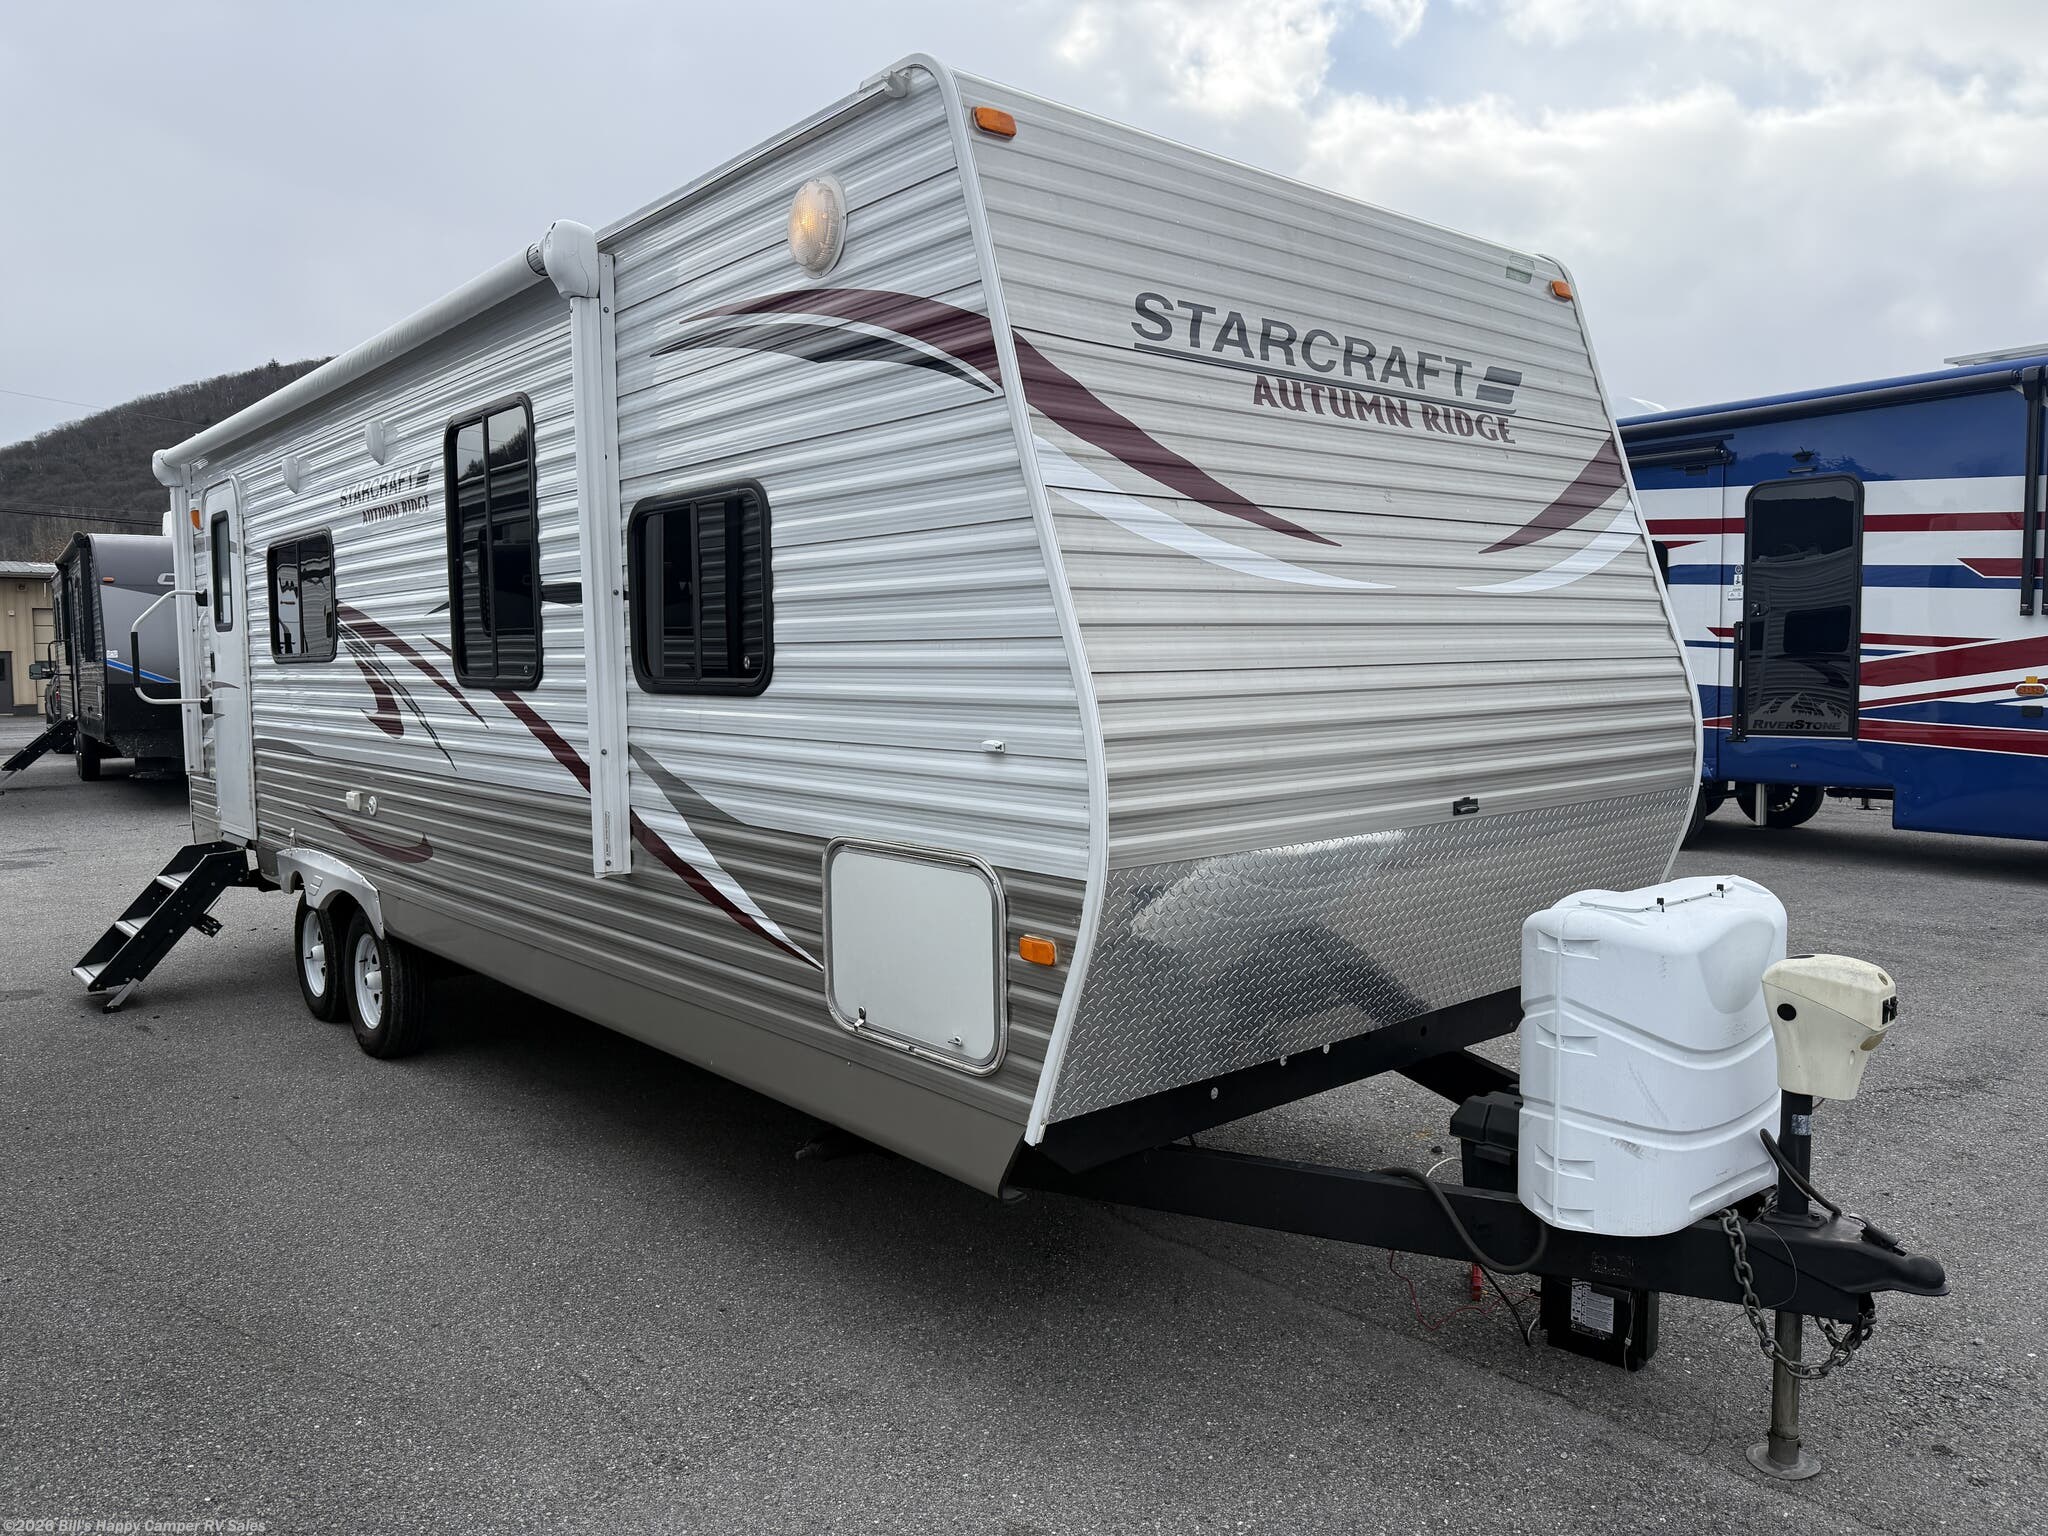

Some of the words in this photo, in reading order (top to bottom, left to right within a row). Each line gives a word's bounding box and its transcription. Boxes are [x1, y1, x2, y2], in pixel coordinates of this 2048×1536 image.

[1130, 292, 1472, 398] STARCRAFT
[1253, 375, 1412, 428] AUTUMN
[1421, 402, 1516, 445] RIDGE
[340, 466, 418, 507] STARCRAFT
[362, 503, 400, 526] AUTUMN
[401, 495, 429, 516] RIDGE
